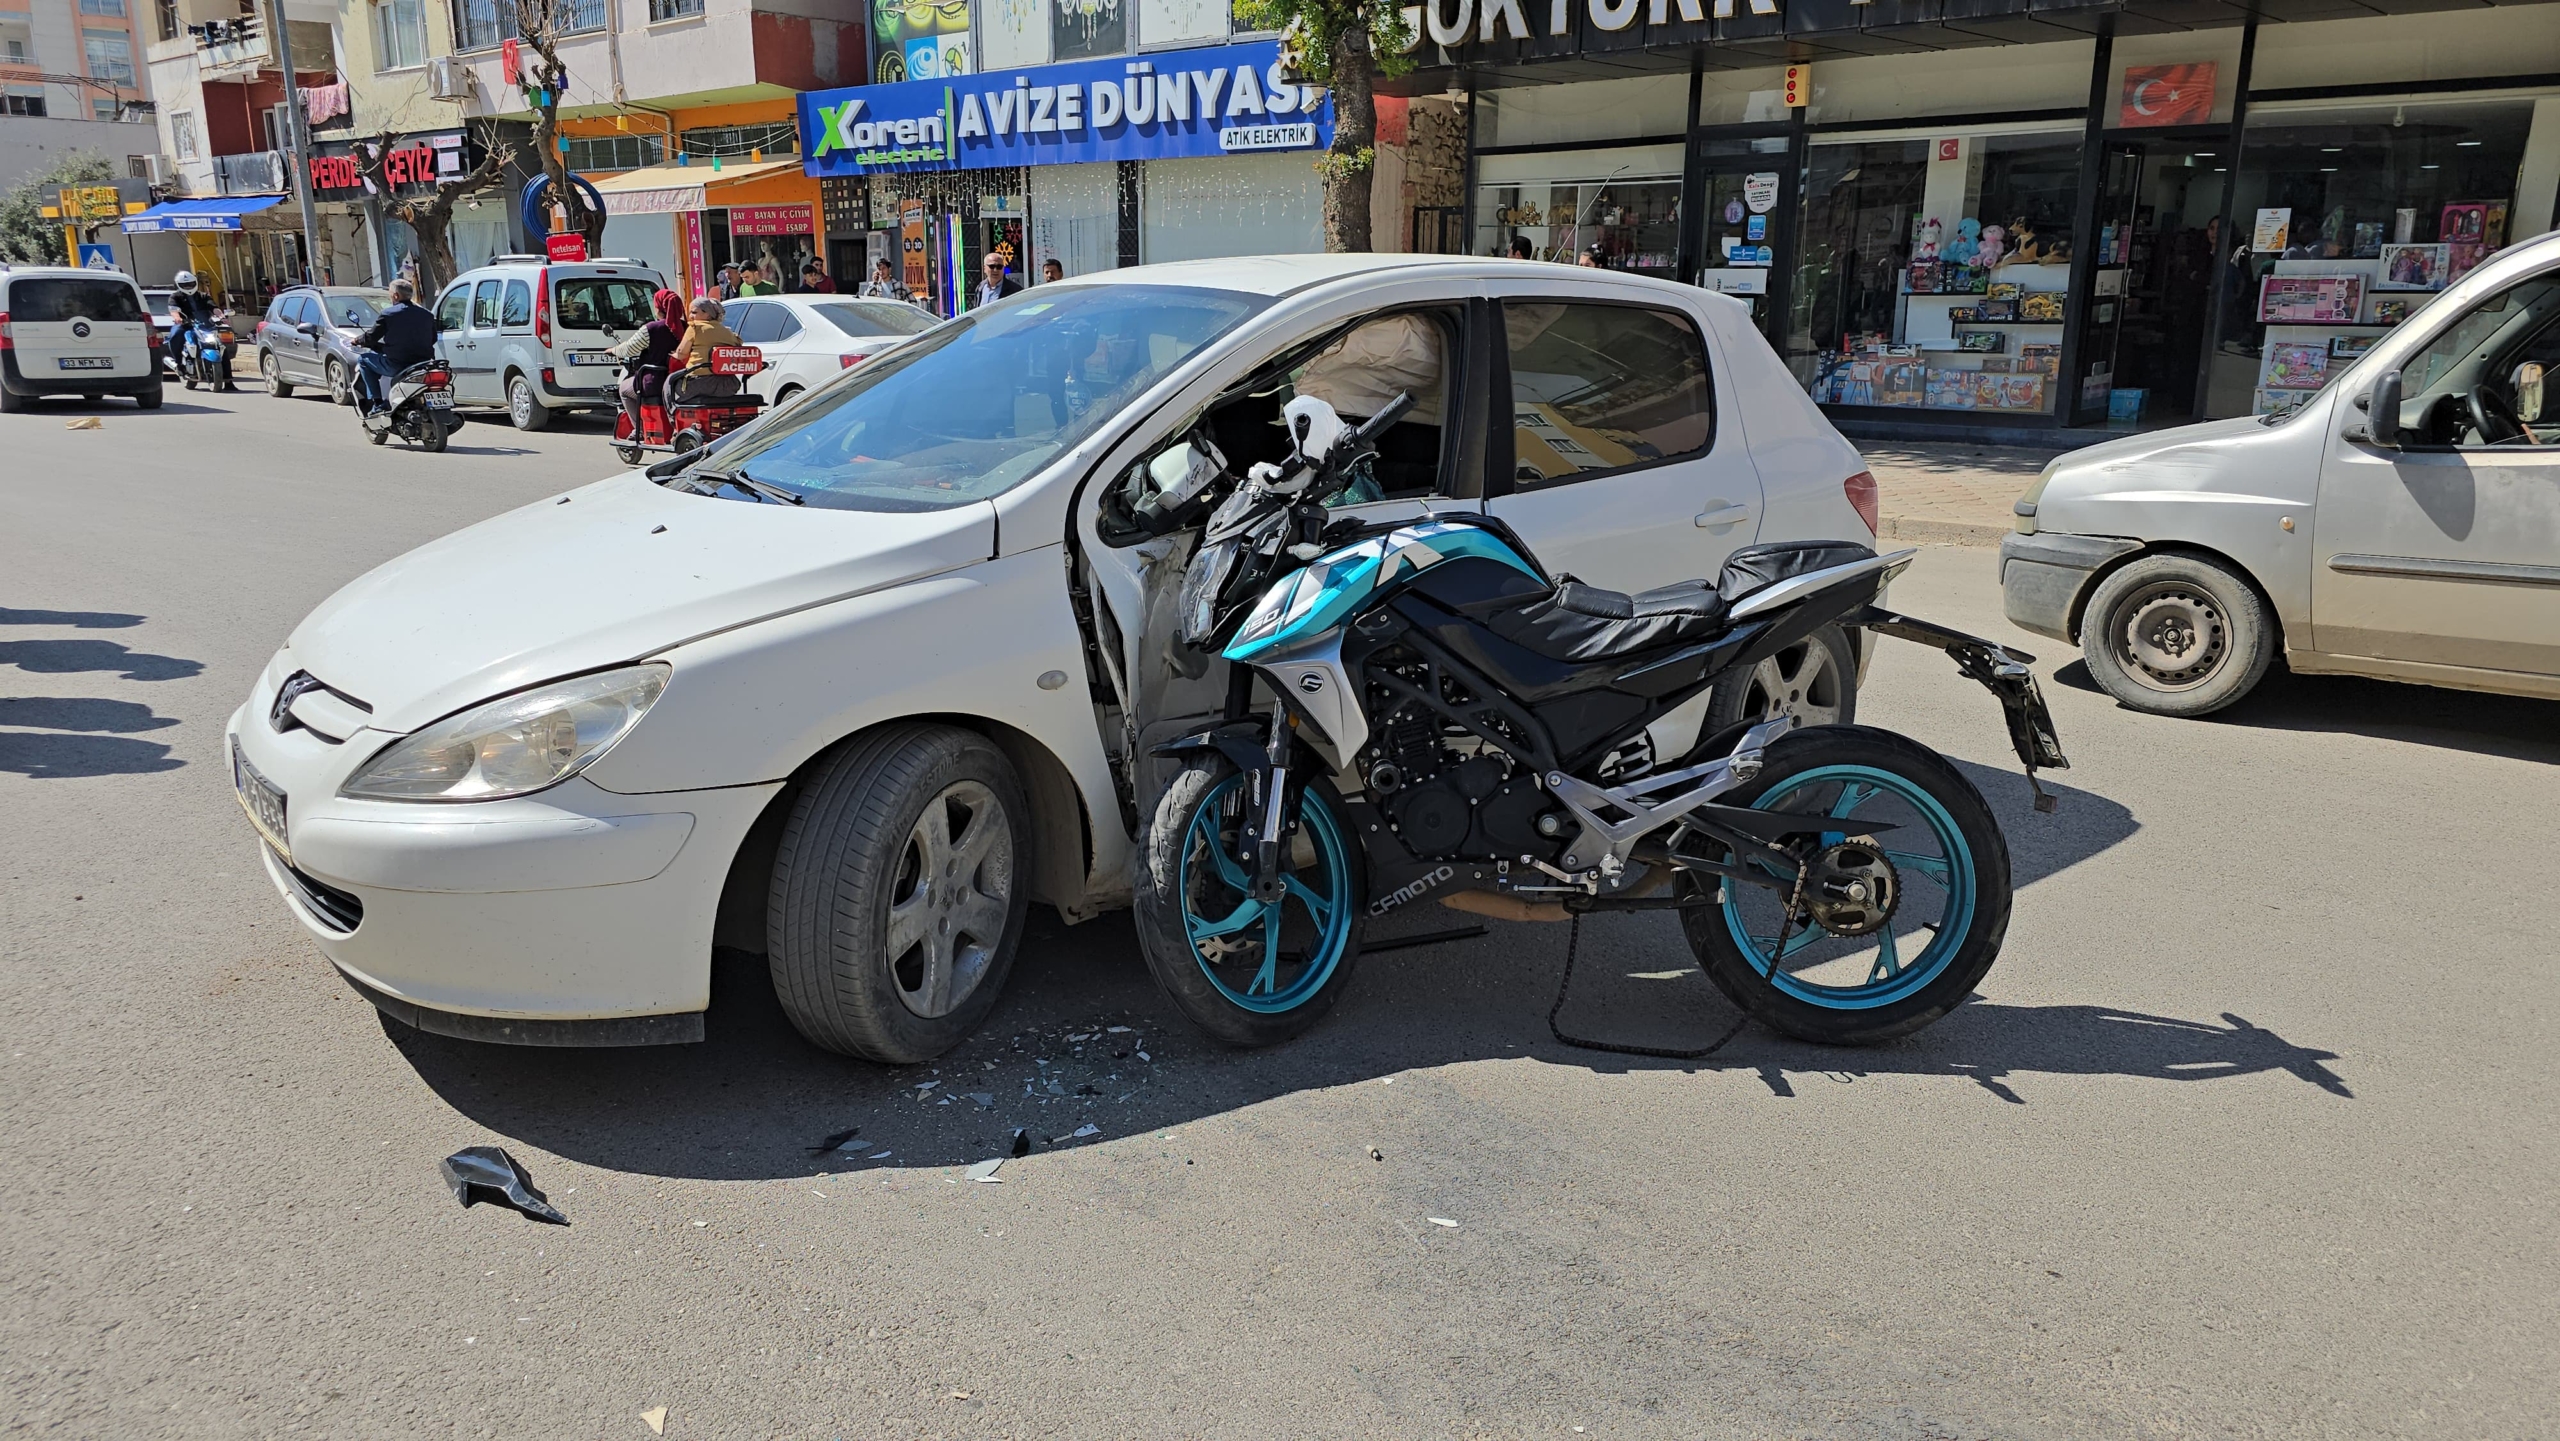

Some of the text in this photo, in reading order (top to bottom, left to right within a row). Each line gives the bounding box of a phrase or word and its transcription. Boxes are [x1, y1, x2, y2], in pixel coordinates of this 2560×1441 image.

[957, 75, 1083, 139] AVİZE
[1225, 123, 1308, 146] ATİK ELEKTRİK
[855, 146, 945, 166] electric
[309, 154, 362, 190] PERDE
[383, 140, 435, 193] ÇEYİZ
[732, 211, 745, 220] BAY
[754, 210, 777, 219] BAYAN
[789, 206, 810, 218] GİYİM
[736, 224, 753, 233] BEBE
[756, 221, 777, 233] GİYİM
[552, 244, 581, 254] netelsan
[65, 359, 76, 367] 33
[78, 359, 95, 367] NFM
[576, 355, 584, 363] 31
[589, 355, 594, 363] P
[720, 361, 758, 372] ACEMİ
[437, 391, 451, 399] ASL
[1243, 607, 1280, 637] 150
[1369, 865, 1455, 917] CFMOTO
